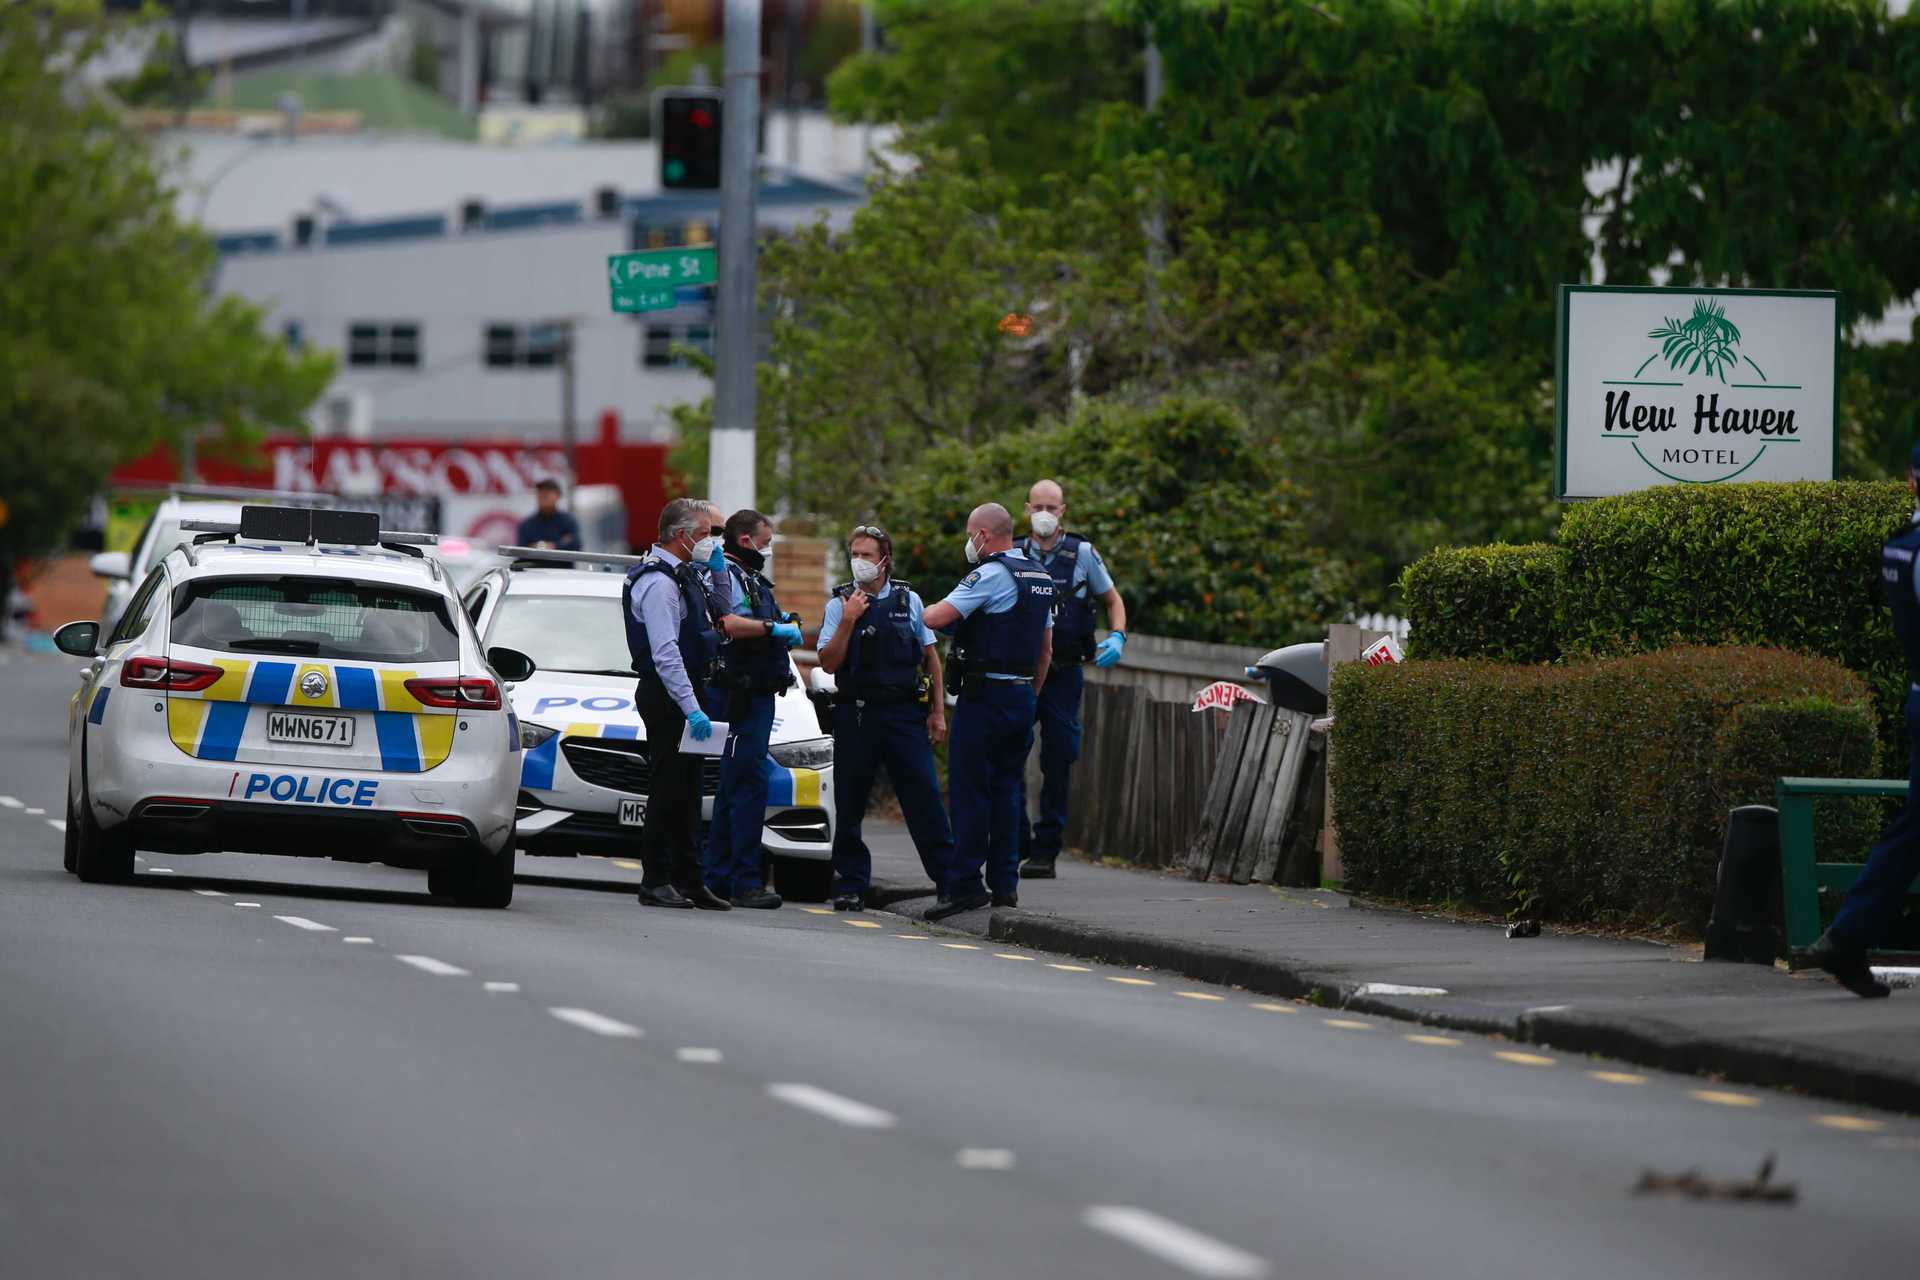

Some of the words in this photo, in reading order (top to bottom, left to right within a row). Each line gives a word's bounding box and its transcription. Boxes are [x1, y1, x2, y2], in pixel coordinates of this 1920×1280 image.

[1604, 391, 1677, 432] New
[1694, 393, 1798, 436] Haven
[1662, 448, 1740, 465] MOTEL
[1031, 586, 1053, 595] POLICE
[271, 716, 347, 741] MWN671
[244, 773, 379, 806] POLICE
